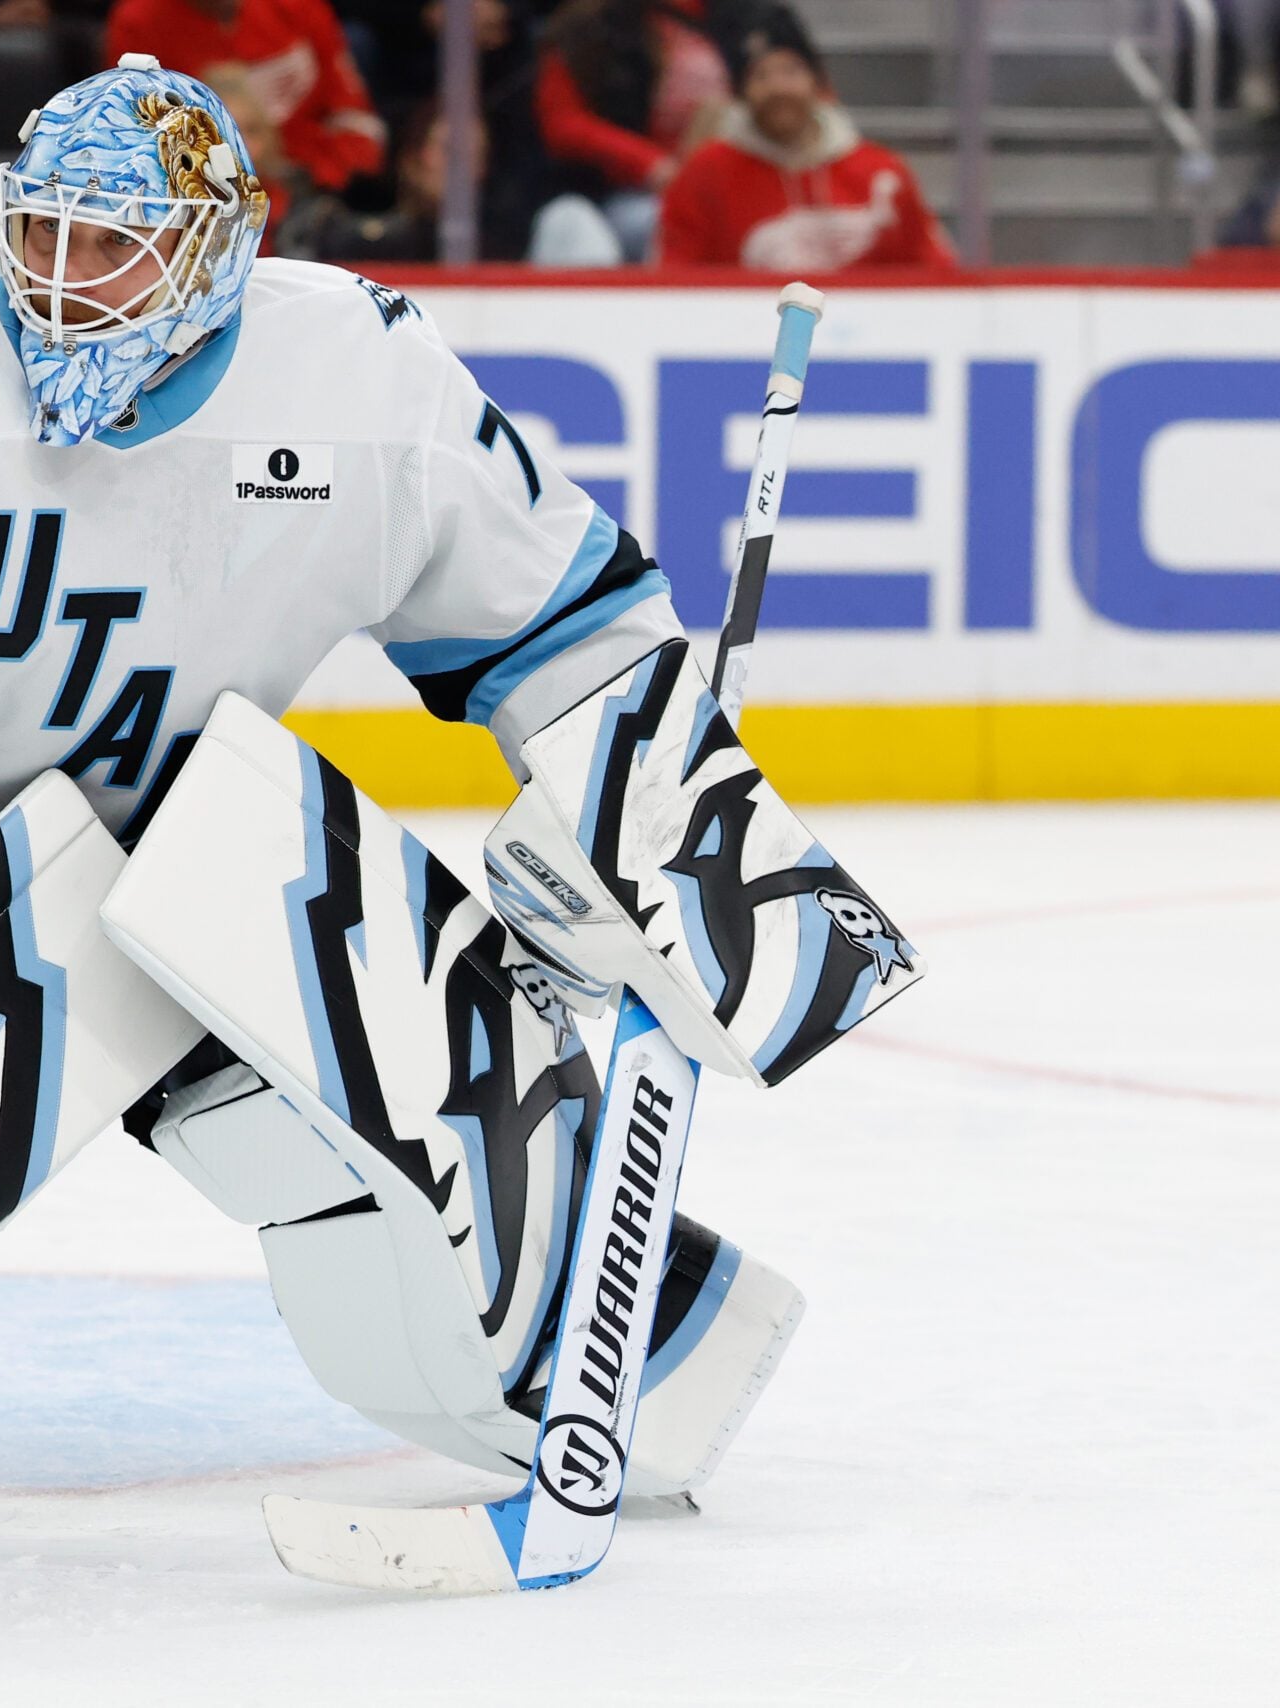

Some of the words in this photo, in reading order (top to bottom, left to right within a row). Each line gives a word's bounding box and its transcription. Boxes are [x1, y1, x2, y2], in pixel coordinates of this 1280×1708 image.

[236, 483, 330, 500] 1Password
[474, 398, 543, 511] 7
[758, 470, 775, 515] RTL
[579, 1074, 674, 1409] WARRIOR
